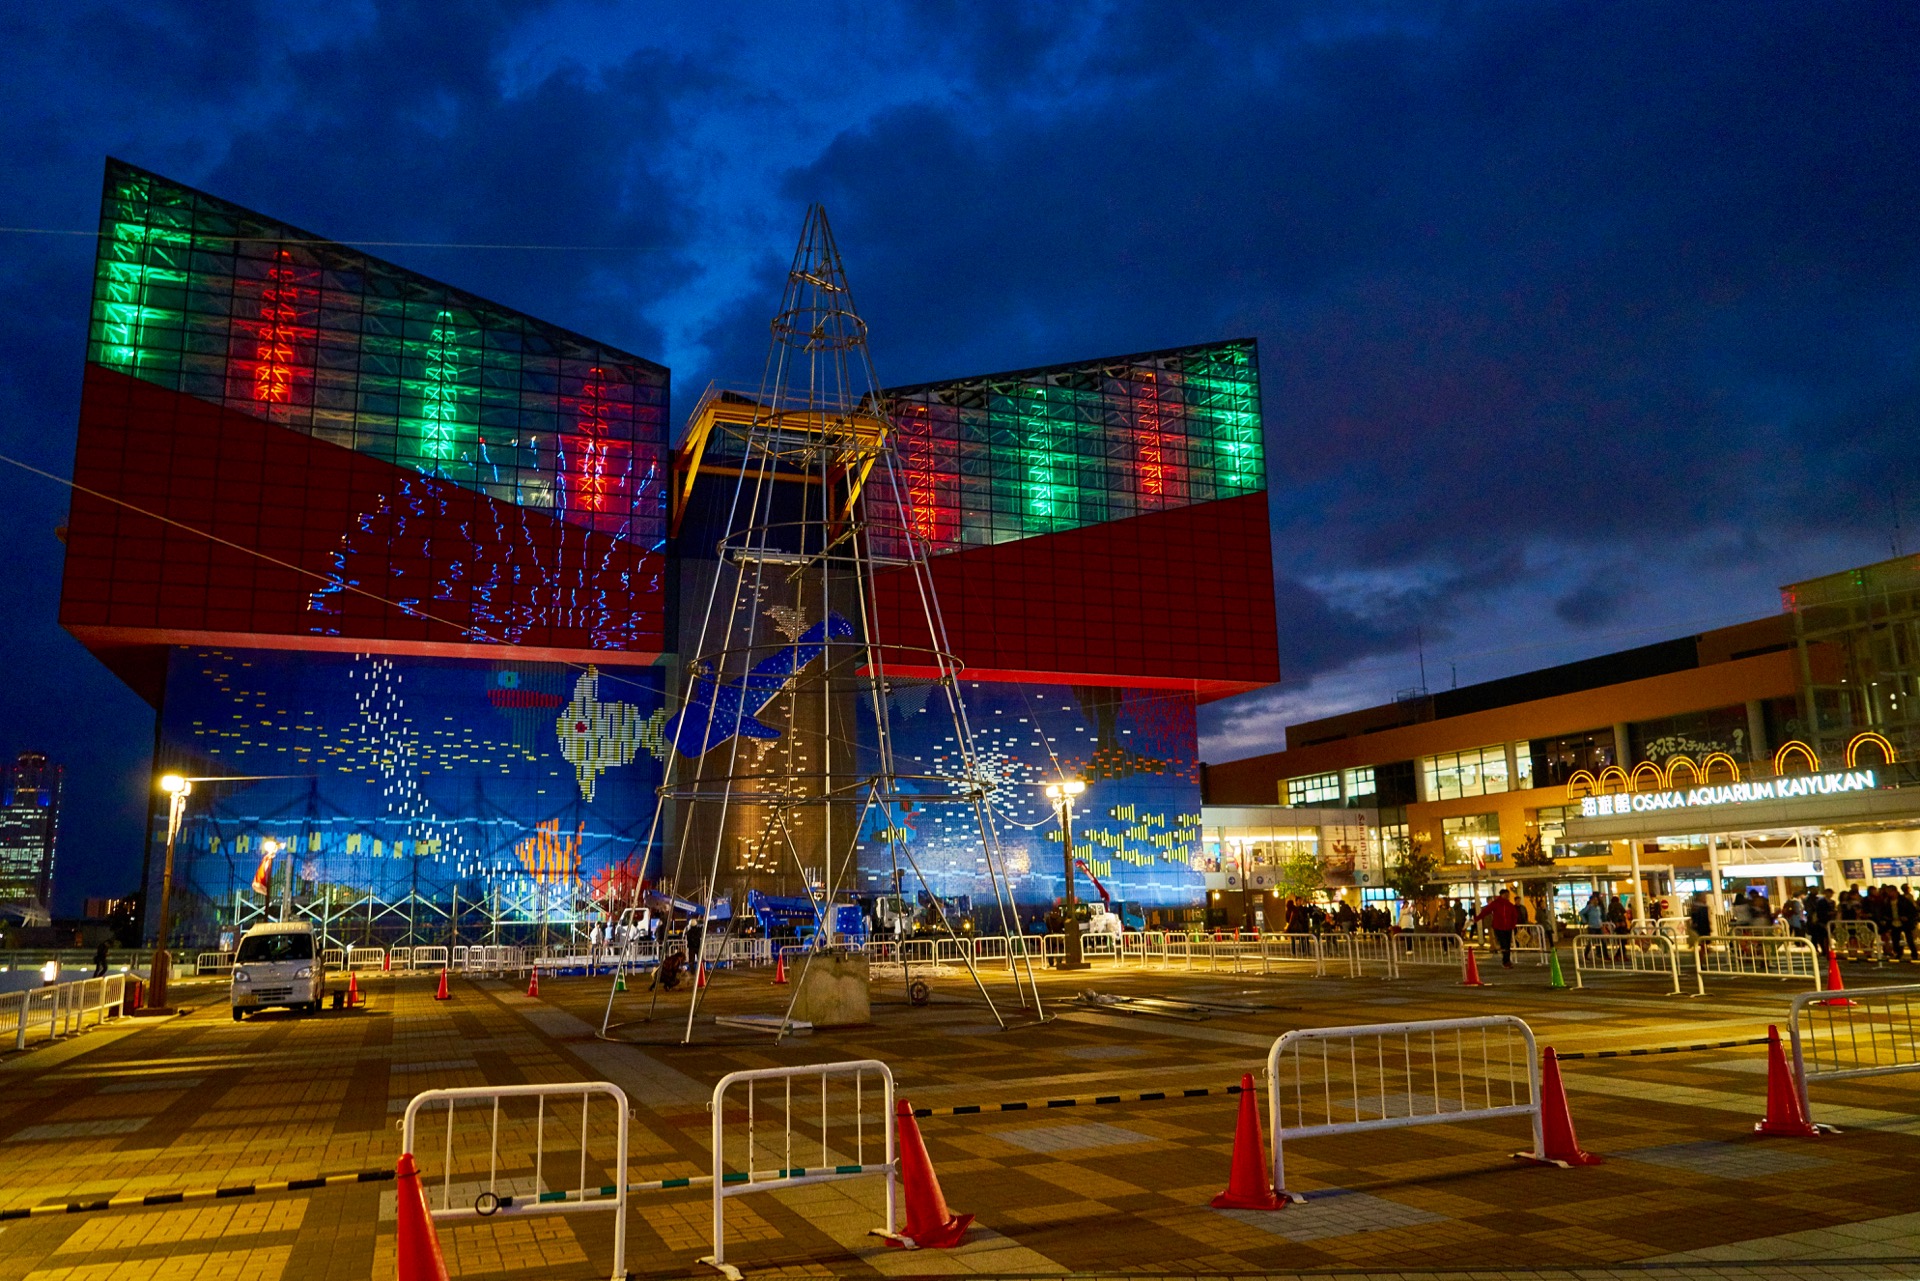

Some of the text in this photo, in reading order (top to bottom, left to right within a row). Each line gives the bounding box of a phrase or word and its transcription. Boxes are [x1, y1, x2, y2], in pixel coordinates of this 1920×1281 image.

[1581, 770, 1875, 817] 海遊館 OSAKA AQUARIUM KAIYUKAN
